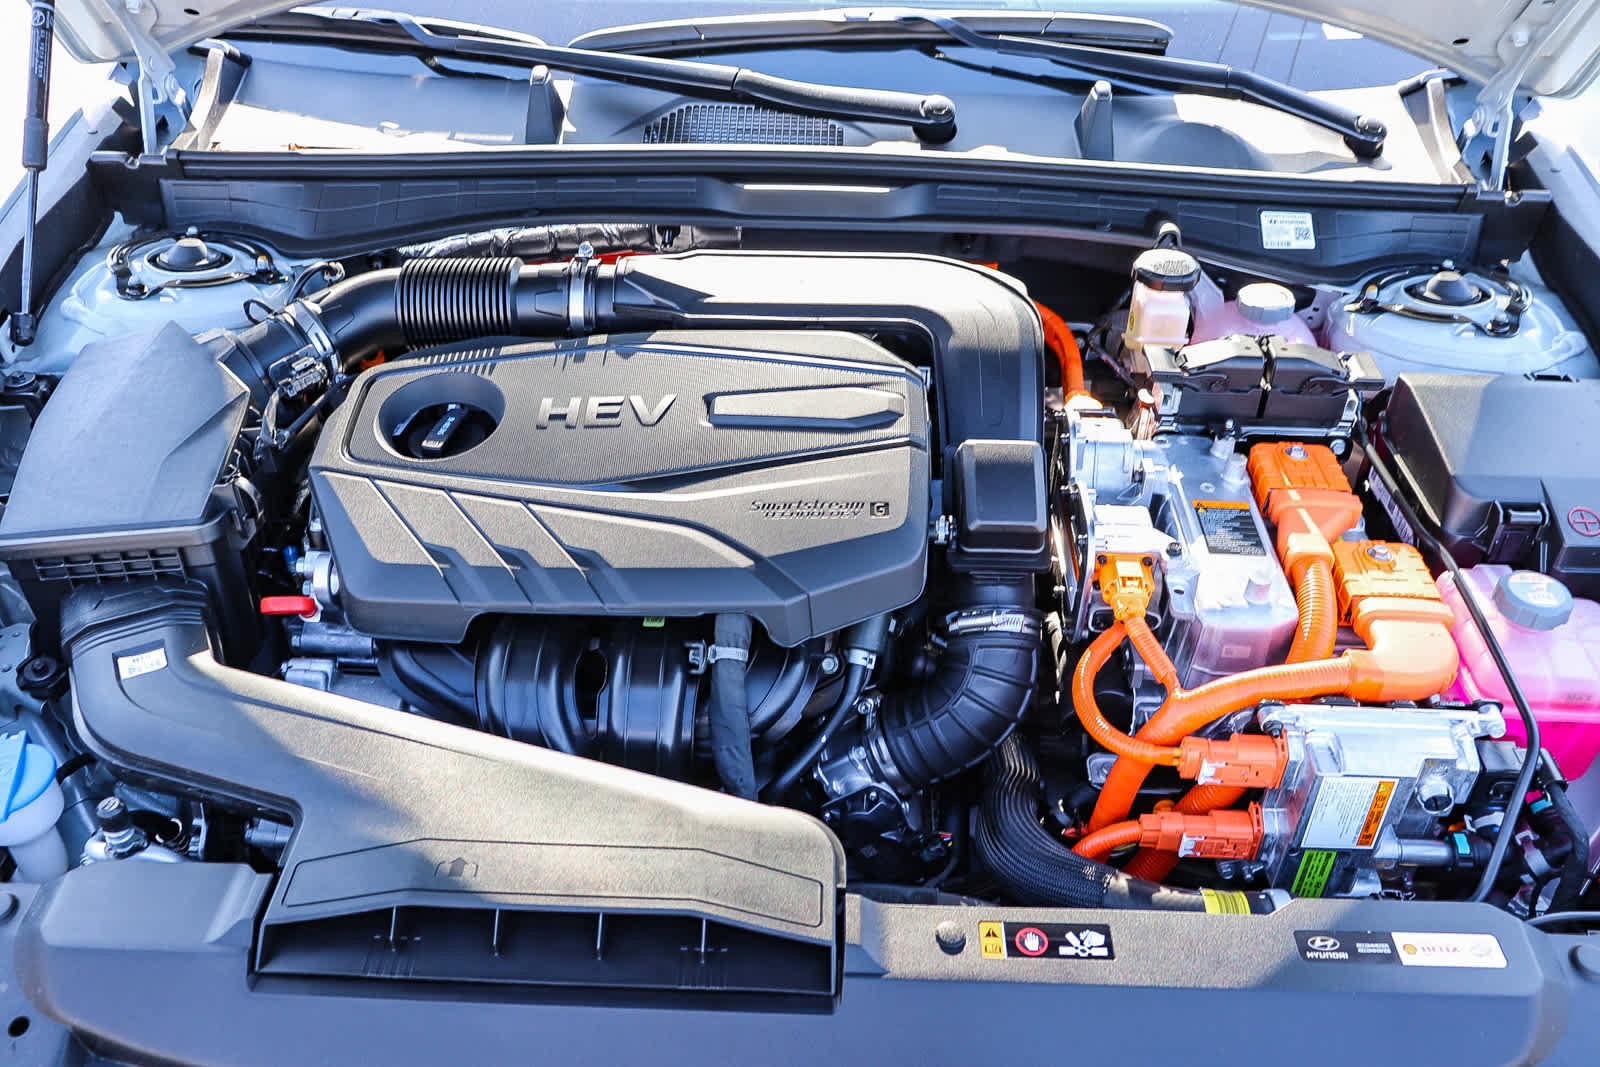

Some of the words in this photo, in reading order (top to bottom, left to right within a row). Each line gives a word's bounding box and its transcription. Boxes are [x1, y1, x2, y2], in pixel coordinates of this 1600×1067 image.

[536, 393, 678, 429] HEV
[751, 499, 866, 511] Smartstream
[873, 502, 886, 515] G
[1306, 951, 1349, 960] HYUNDAI
